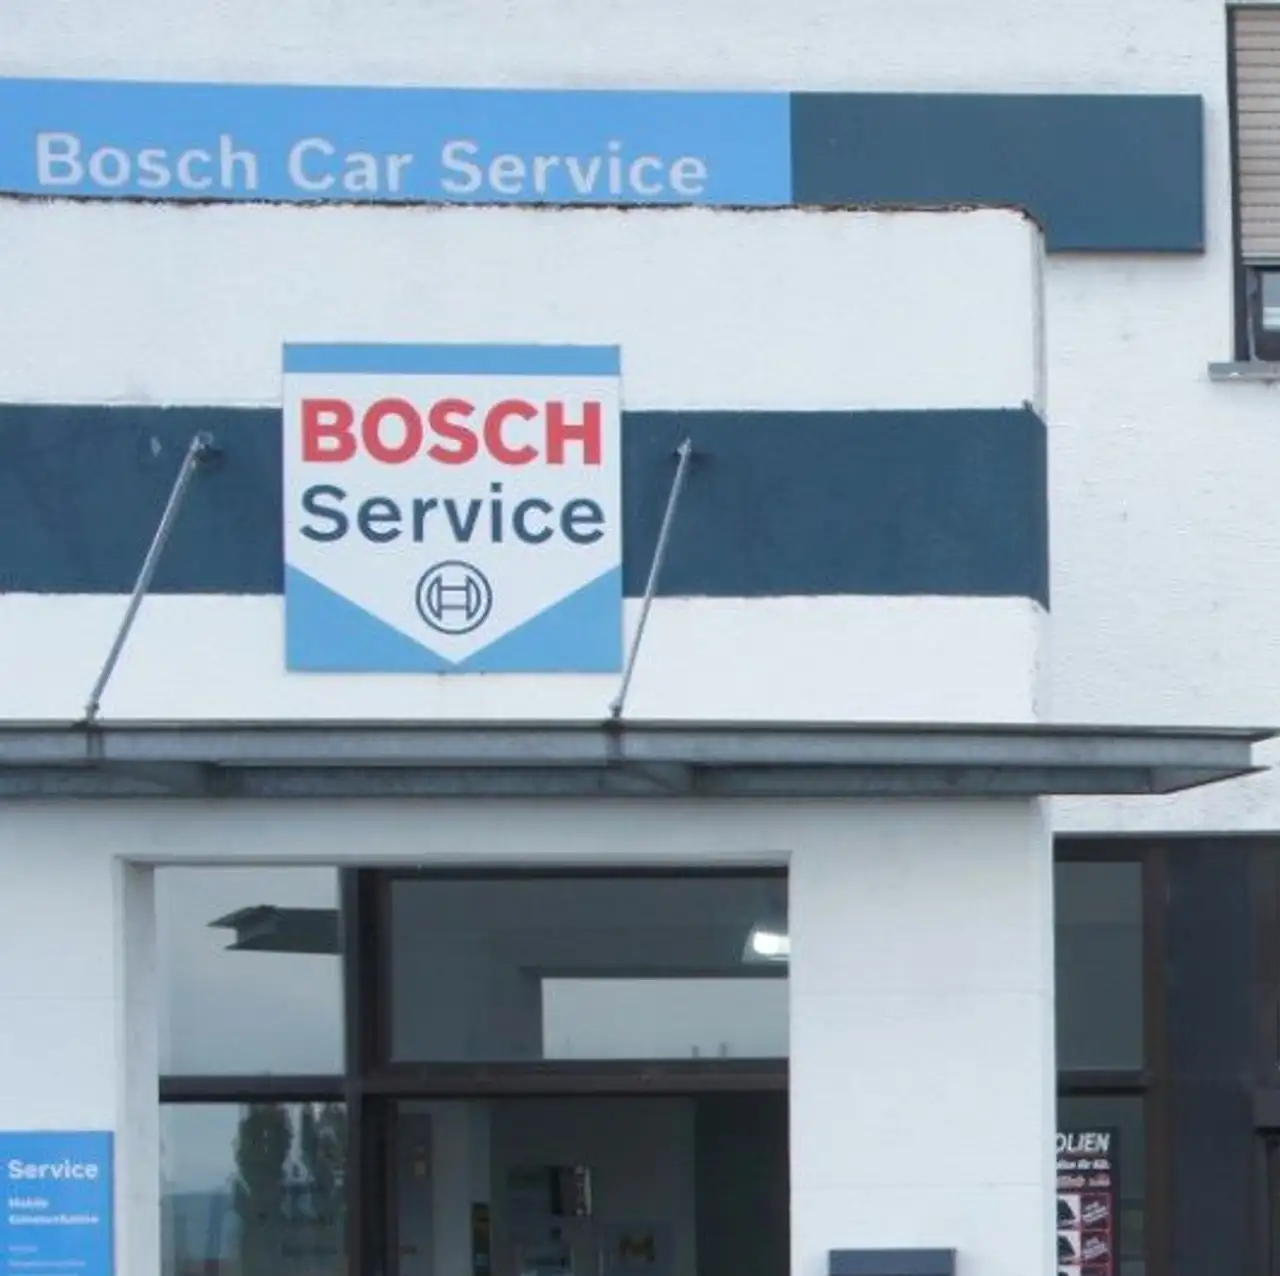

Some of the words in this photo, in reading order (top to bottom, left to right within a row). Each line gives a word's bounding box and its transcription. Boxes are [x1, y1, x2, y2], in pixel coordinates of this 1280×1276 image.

[36, 132, 257, 189] Bosch
[288, 139, 413, 193] Car
[440, 142, 707, 196] Service
[301, 398, 602, 465] BOSCH
[299, 482, 606, 544] Service
[8, 1159, 99, 1180] Service
